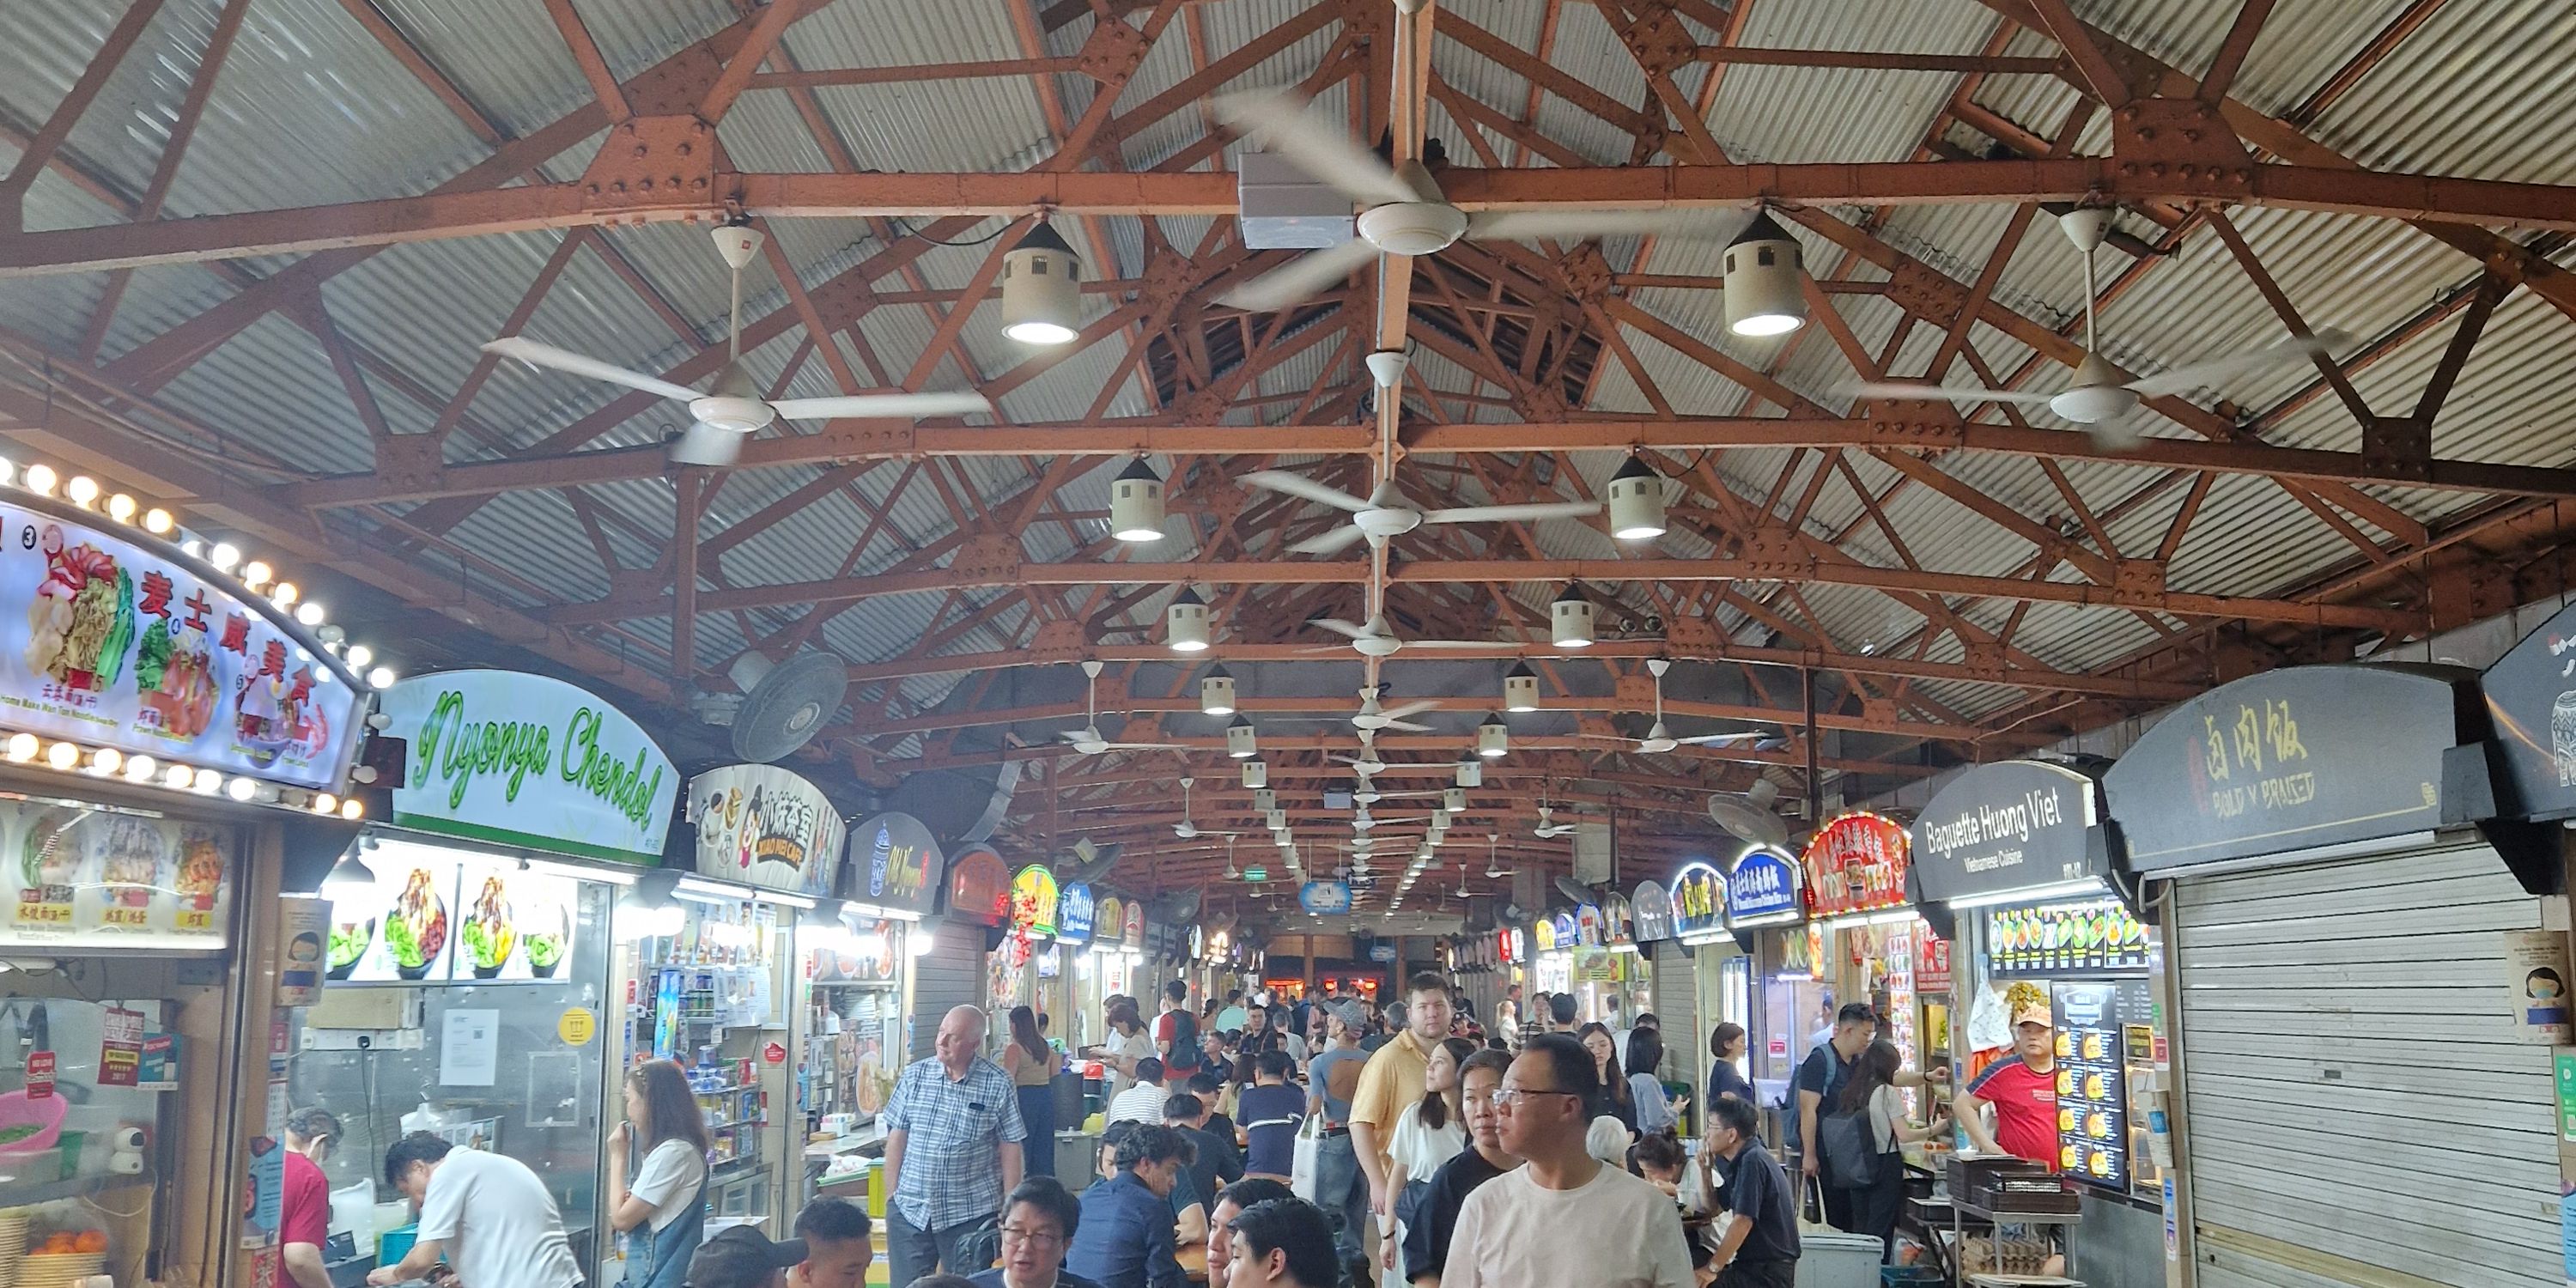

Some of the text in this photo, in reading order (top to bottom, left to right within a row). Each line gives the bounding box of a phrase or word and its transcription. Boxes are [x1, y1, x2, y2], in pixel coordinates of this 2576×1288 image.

[412, 690, 662, 831] Nyonya Chendol
[2212, 787, 2245, 818] BOLD
[2261, 771, 2315, 810] BRAISED
[1925, 811, 1980, 860] Baguette
[1980, 804, 2029, 842] Huong
[2026, 787, 2063, 829] Viet
[775, 838, 786, 857] MEI
[1964, 848, 2024, 874] Vietnamese Cuisine
